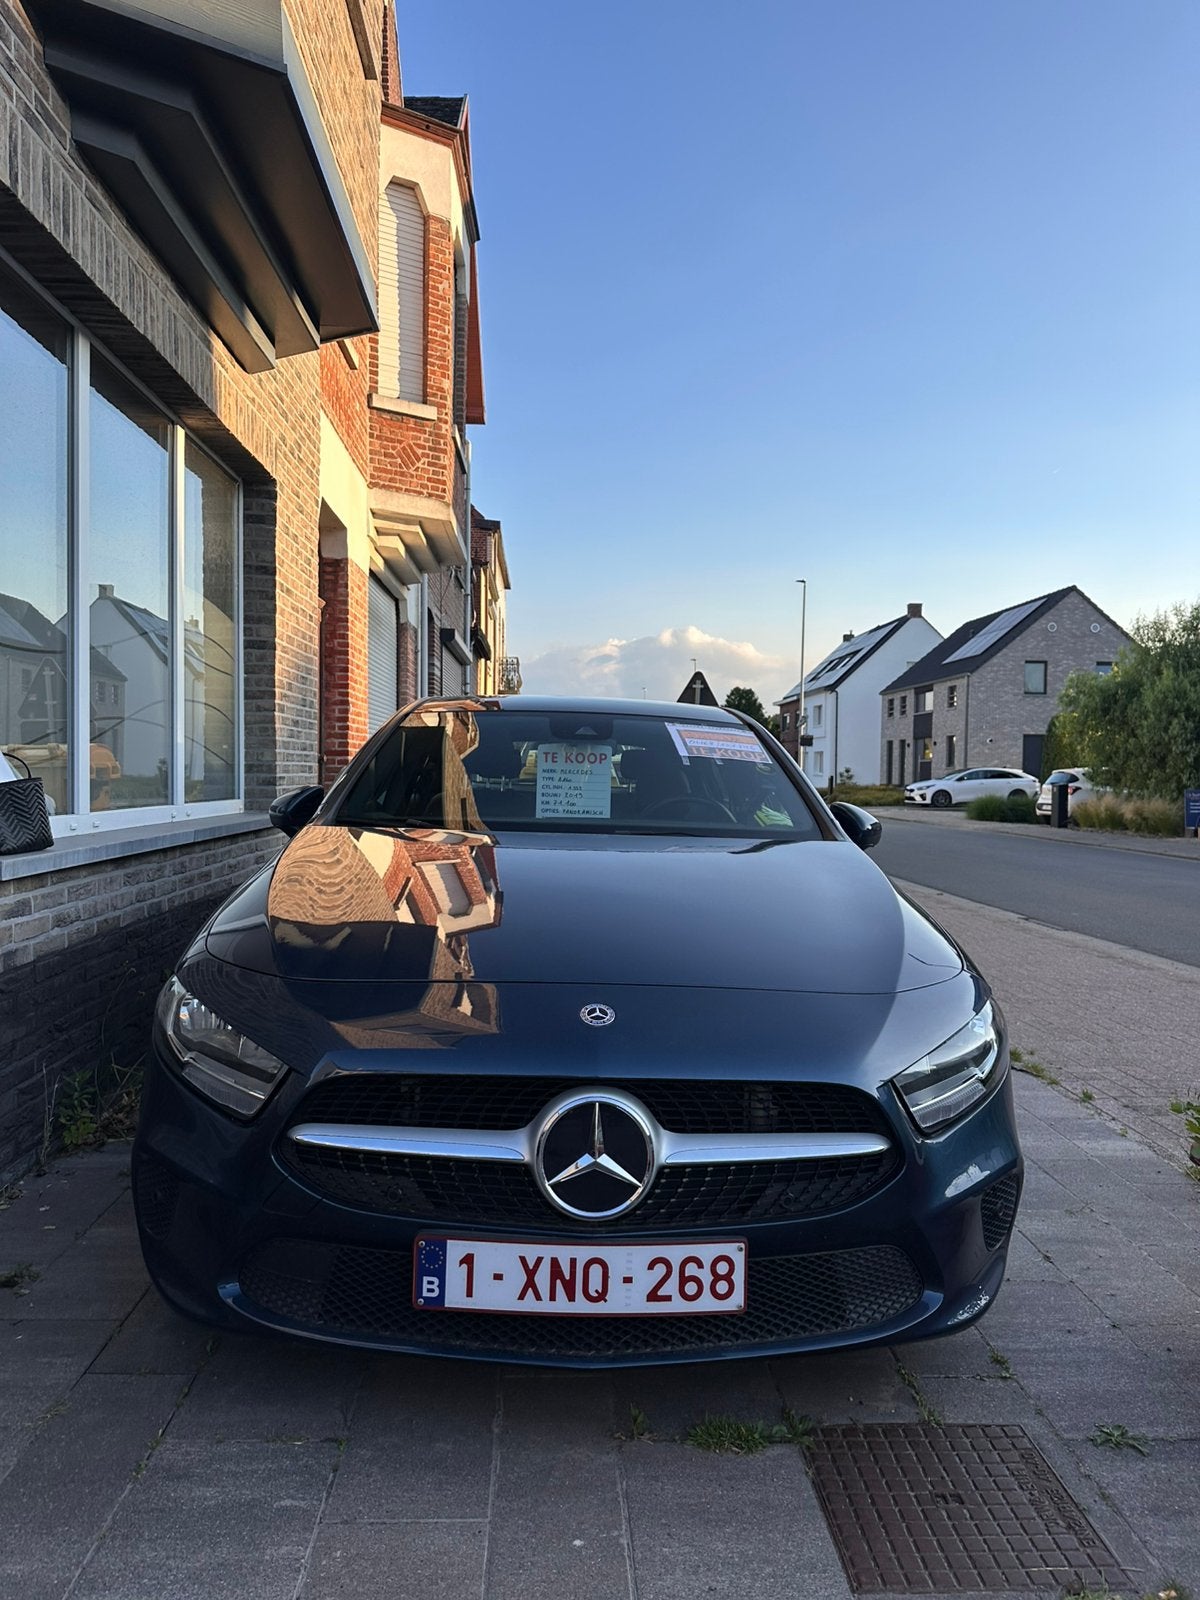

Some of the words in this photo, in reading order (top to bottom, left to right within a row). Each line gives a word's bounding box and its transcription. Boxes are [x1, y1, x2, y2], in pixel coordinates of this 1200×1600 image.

[543, 751, 558, 764] TE
[564, 751, 608, 765] KOOP
[690, 746, 710, 756] TE
[714, 747, 766, 759] KOOP
[422, 1275, 440, 1298] B
